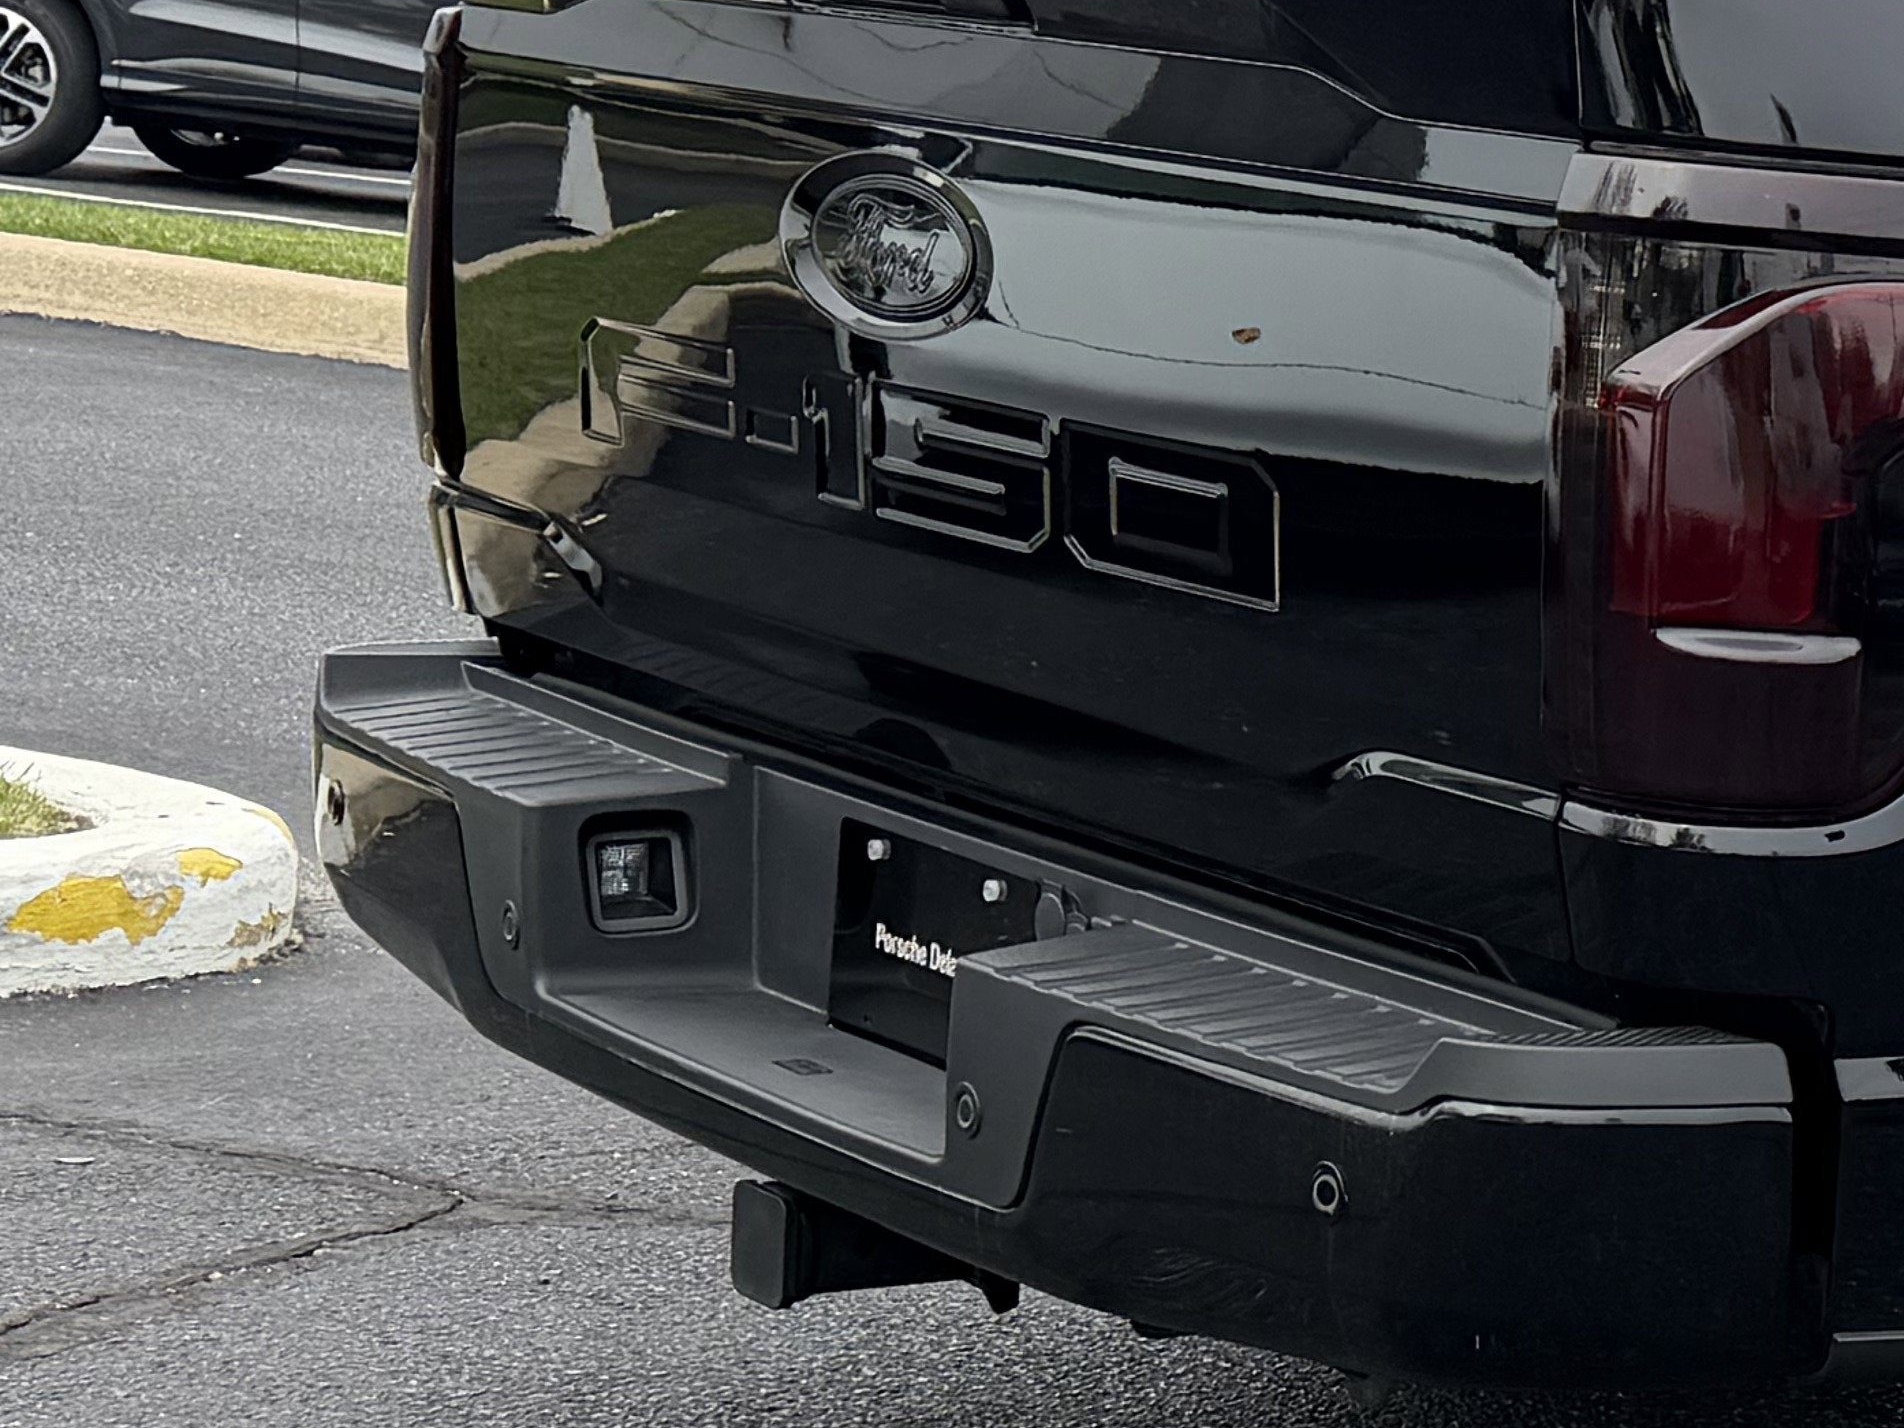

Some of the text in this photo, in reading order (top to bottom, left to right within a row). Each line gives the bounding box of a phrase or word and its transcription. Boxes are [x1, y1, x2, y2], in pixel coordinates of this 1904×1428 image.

[834, 192, 939, 294] Ford
[579, 315, 1281, 613] F-150
[875, 922, 927, 966] Porsche
